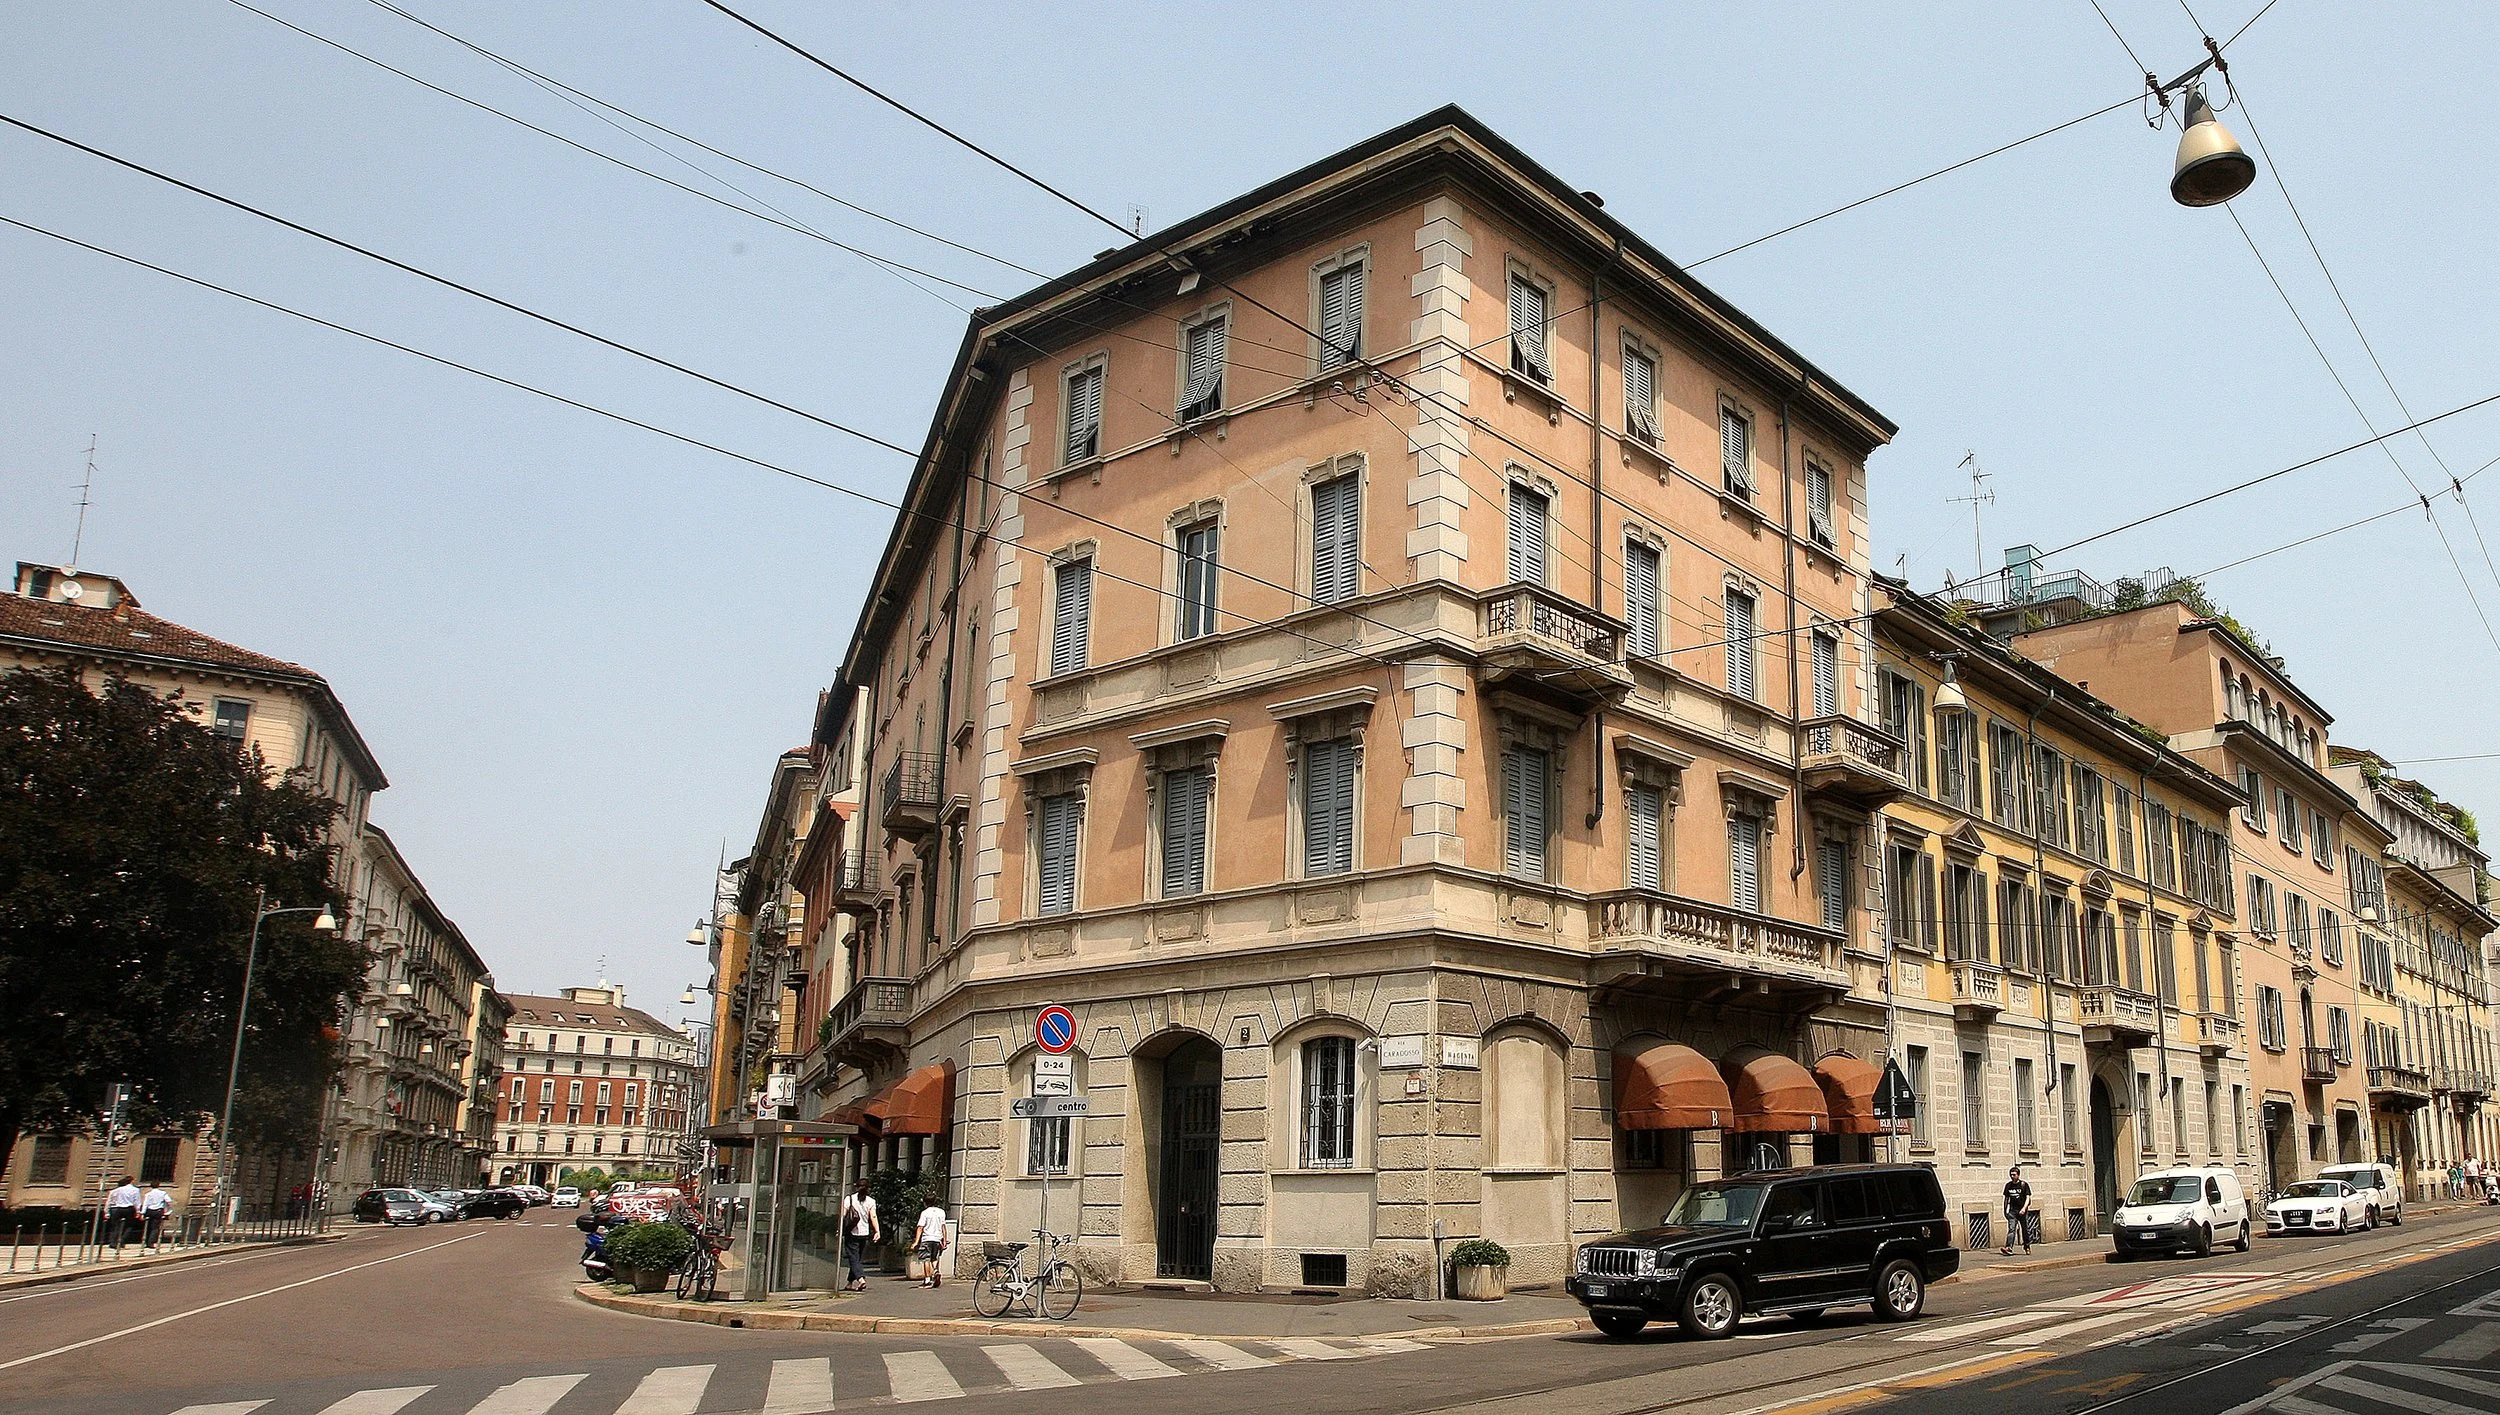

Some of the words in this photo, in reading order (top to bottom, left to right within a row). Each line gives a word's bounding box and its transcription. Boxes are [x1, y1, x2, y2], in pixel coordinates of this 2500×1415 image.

[1242, 1028, 1248, 1038] 2
[1043, 1061, 1064, 1069] 0-24
[1057, 1102, 1087, 1111] centro
[1711, 1110, 1719, 1127] B
[1811, 1115, 1817, 1131] B
